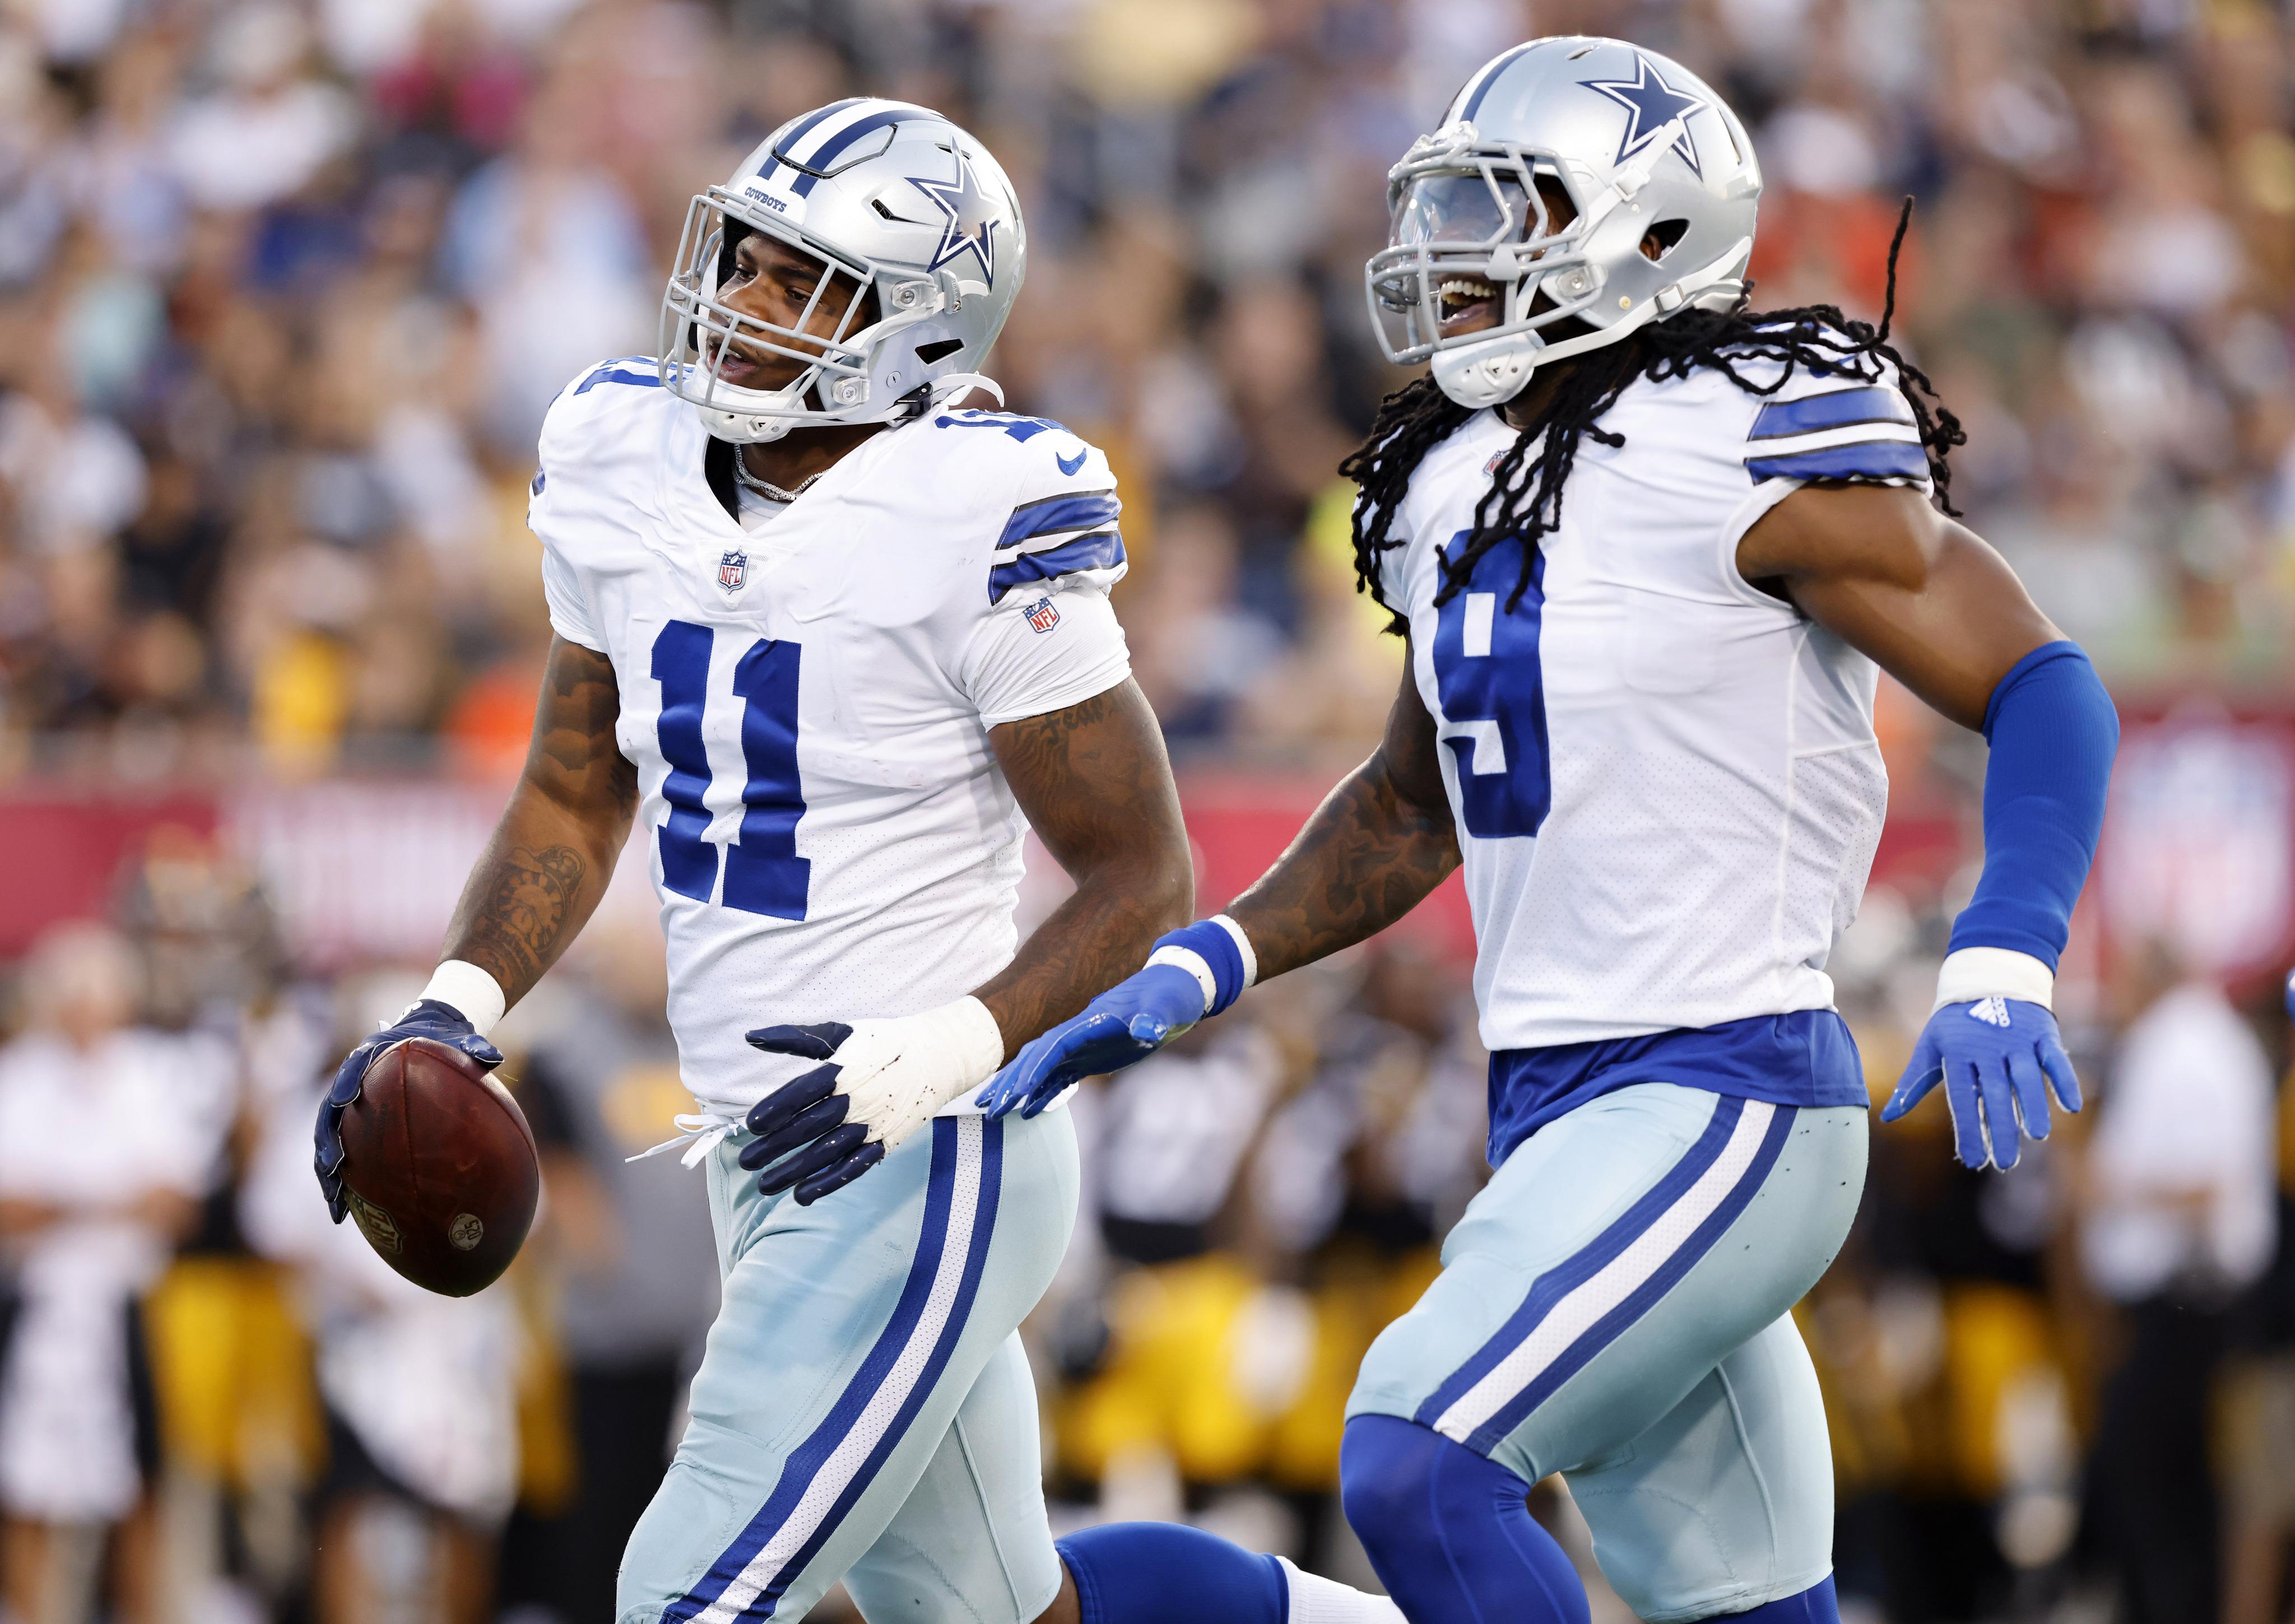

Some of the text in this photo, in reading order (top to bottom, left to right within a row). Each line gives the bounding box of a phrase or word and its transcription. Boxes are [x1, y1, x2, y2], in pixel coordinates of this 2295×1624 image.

[745, 187, 787, 212] COWBOYS
[721, 566, 740, 585] NFL
[1030, 608, 1057, 631] NFL
[1432, 528, 1551, 839] 9
[651, 620, 811, 922] 11
